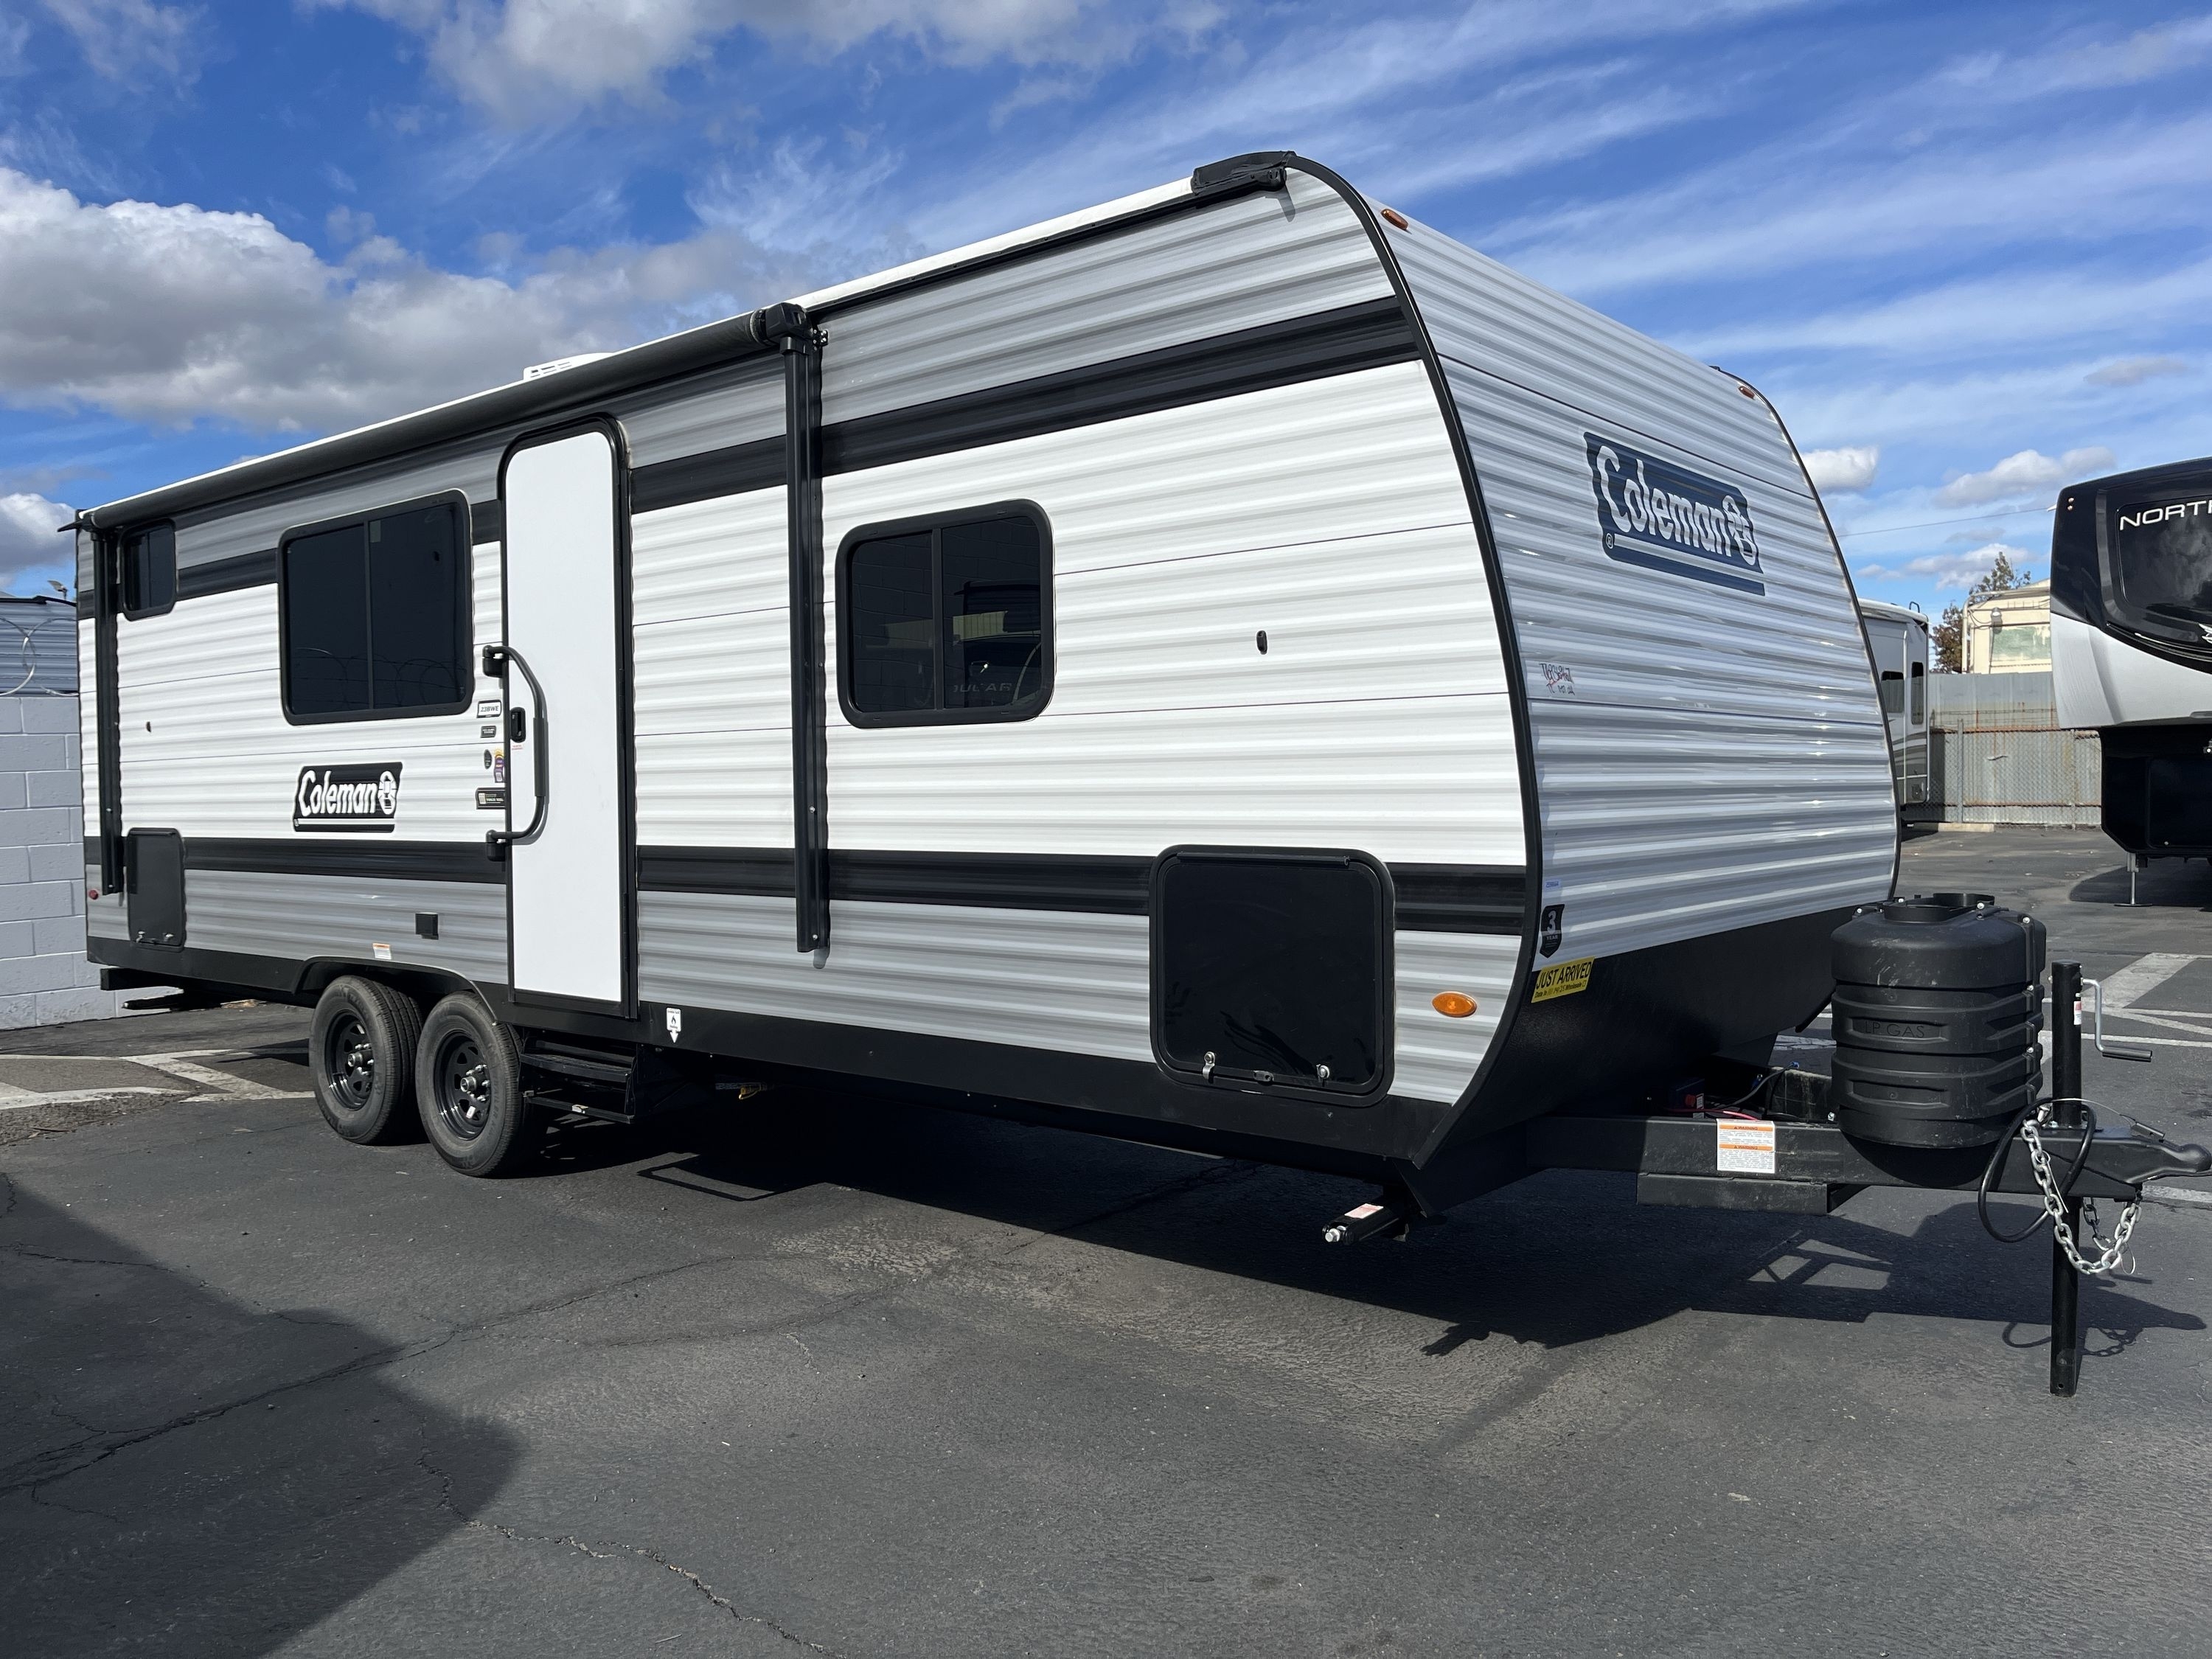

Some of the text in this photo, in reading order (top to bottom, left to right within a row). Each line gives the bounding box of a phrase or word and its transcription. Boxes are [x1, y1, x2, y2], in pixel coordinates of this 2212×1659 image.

[1596, 445, 1732, 557] Coleman
[298, 770, 378, 817] Coleman
[1547, 910, 1556, 934] 3
[1536, 961, 1591, 990] JUST ARRIVED
[1865, 1020, 1924, 1038] LP GAS
